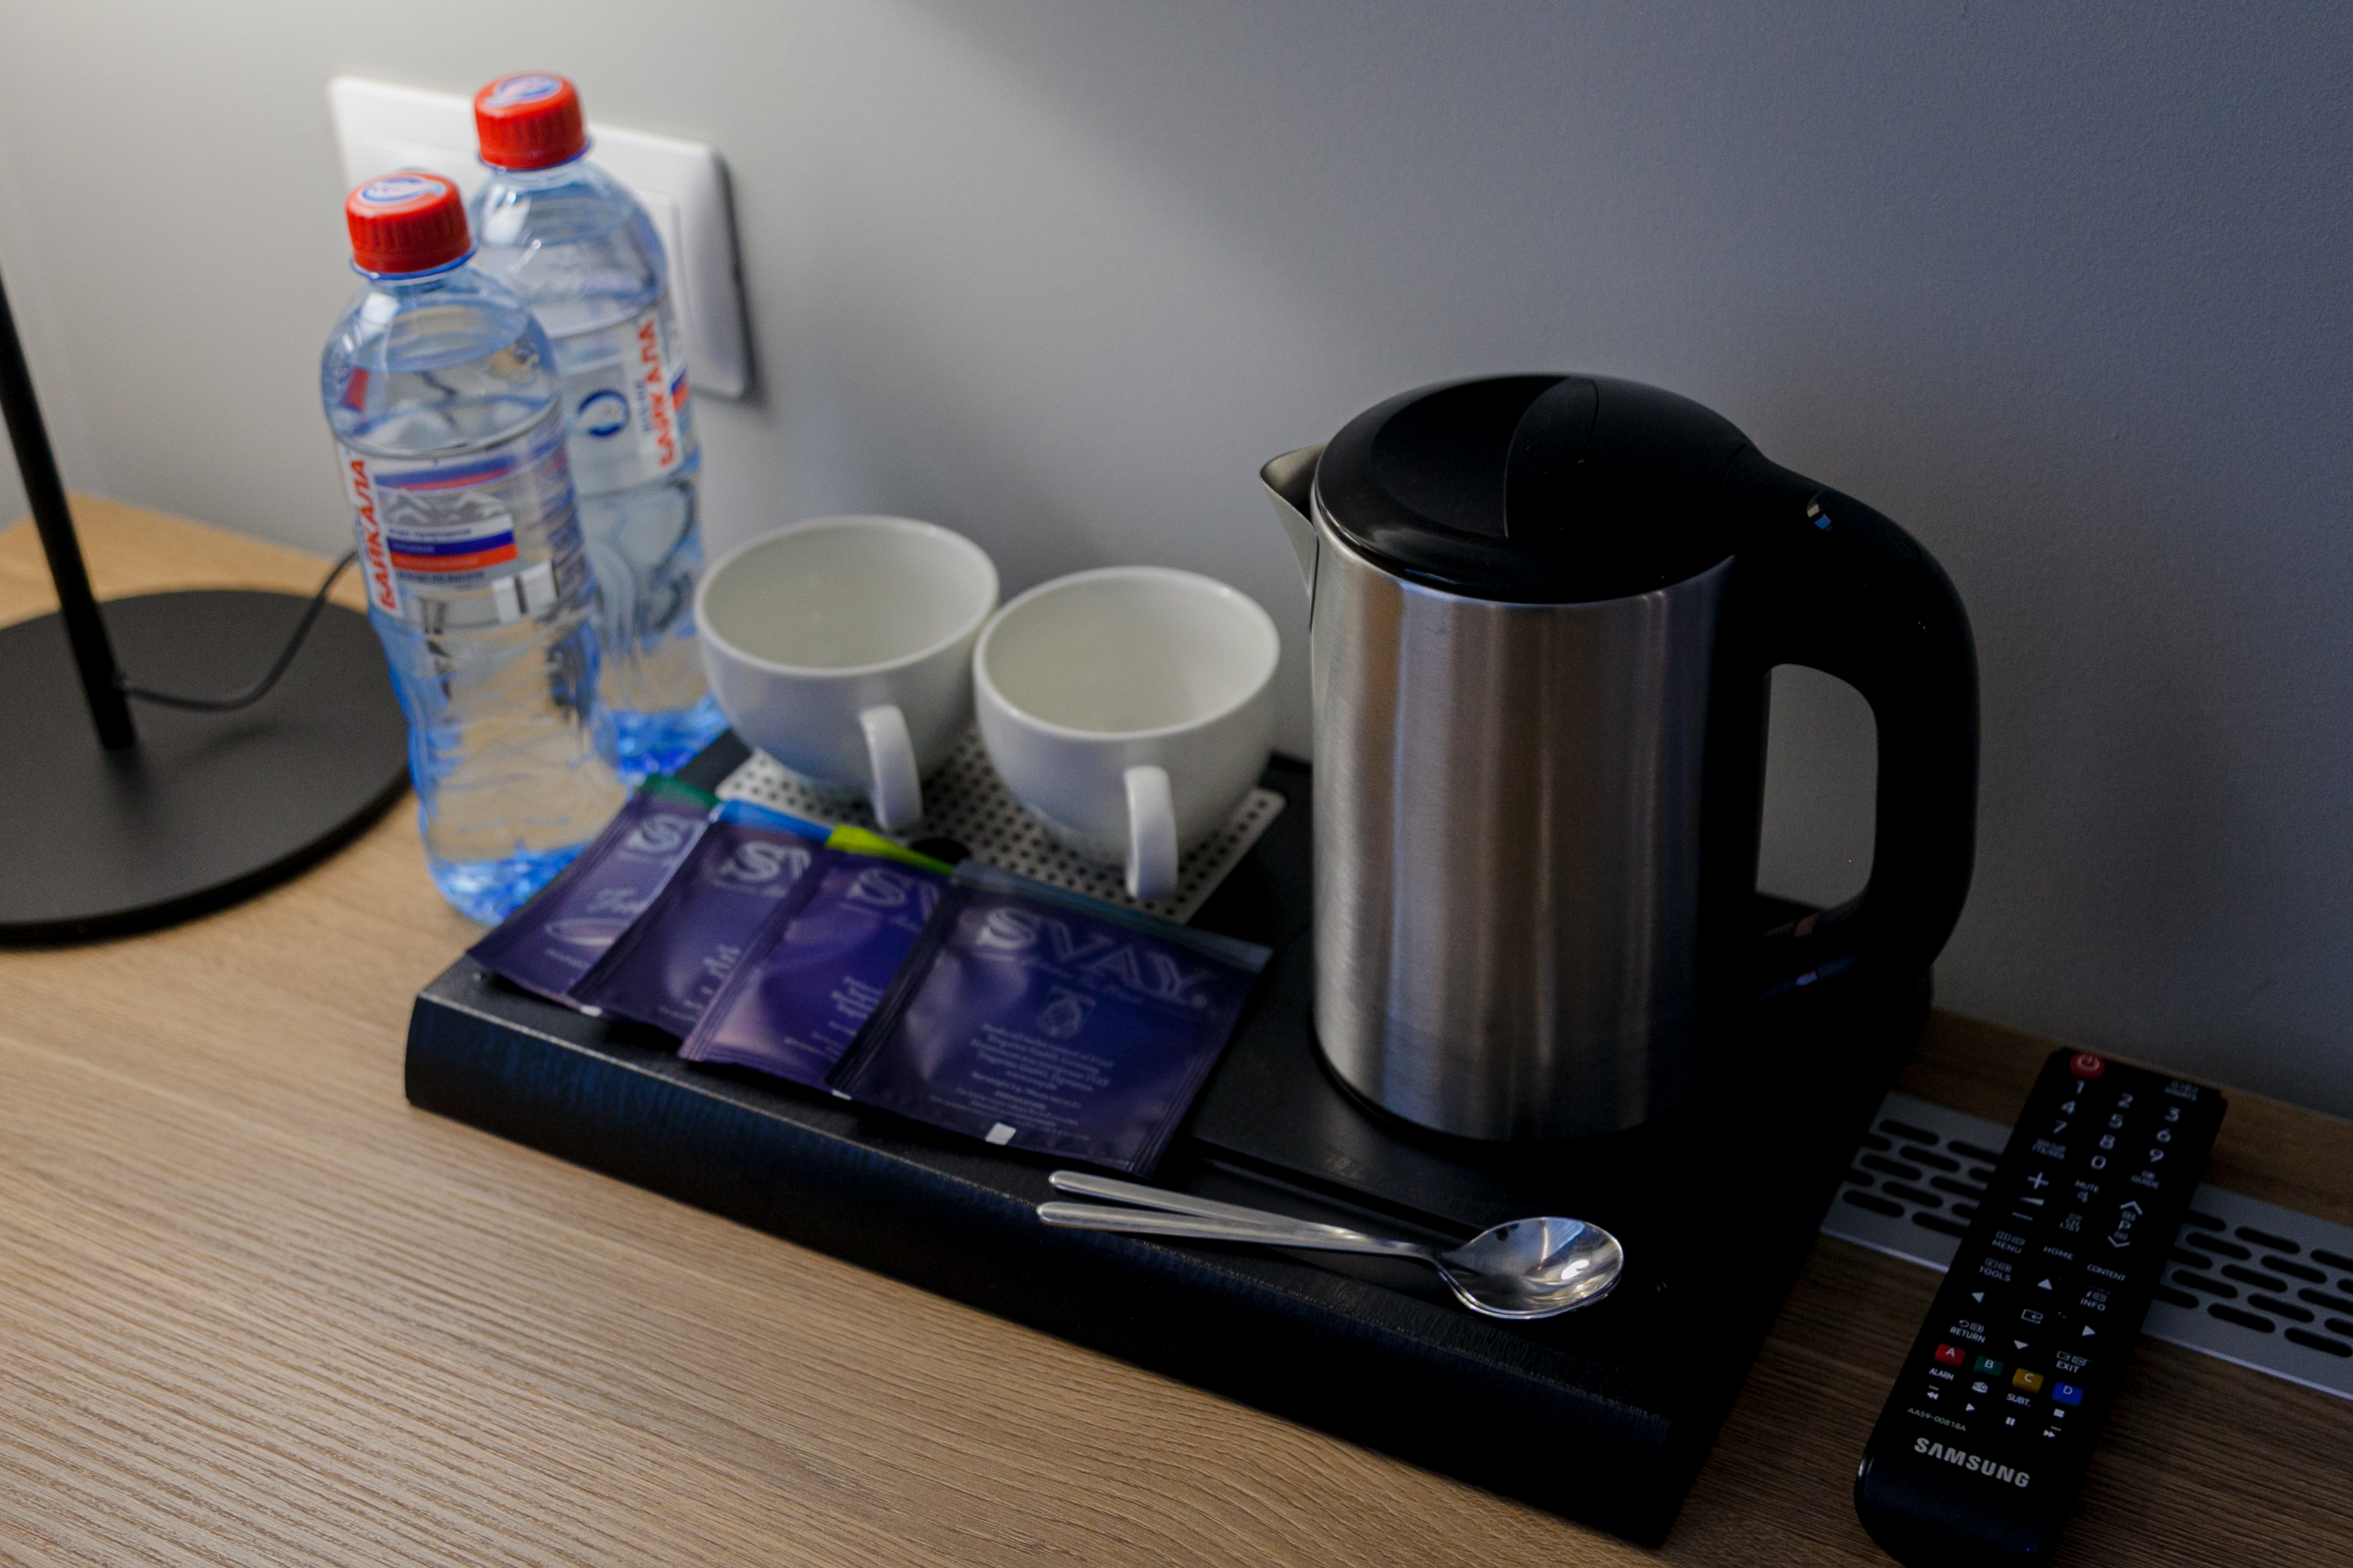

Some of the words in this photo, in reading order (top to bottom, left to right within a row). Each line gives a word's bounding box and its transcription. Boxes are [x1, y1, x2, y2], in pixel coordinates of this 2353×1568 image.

[350, 459, 397, 610] БАЙКАЛА
[2076, 1079, 2086, 1095] 1
[2060, 1100, 2077, 1115] 4
[2117, 1091, 2134, 1110] 2
[2108, 1112, 2125, 1129] 5
[2163, 1106, 2182, 1123] 3
[2052, 1118, 2069, 1135] 7
[2098, 1133, 2116, 1150] 8
[2155, 1128, 2172, 1143] 6
[2090, 1154, 2107, 1170] 0
[2148, 1148, 2165, 1164] 9
[2074, 1179, 2101, 1194] MUTE
[2130, 1174, 2161, 1190] GUIDE
[2059, 1221, 2082, 1233] LIST
[2117, 1220, 2132, 1231] P
[1991, 1239, 2023, 1255] MENU
[2042, 1245, 2075, 1261] HOME
[1978, 1264, 2012, 1282] TOOLS
[2086, 1264, 2127, 1282] CONTENT
[2080, 1297, 2107, 1312] INFO
[1949, 1326, 1986, 1344] RETURN
[1945, 1347, 1956, 1358] A
[1984, 1359, 1994, 1369] B
[2056, 1359, 2080, 1374] EXIT
[1928, 1367, 1955, 1382] ALARM
[2024, 1373, 2034, 1383] C
[2062, 1384, 2073, 1395] D
[1913, 1436, 2031, 1488] SAMSUNG
